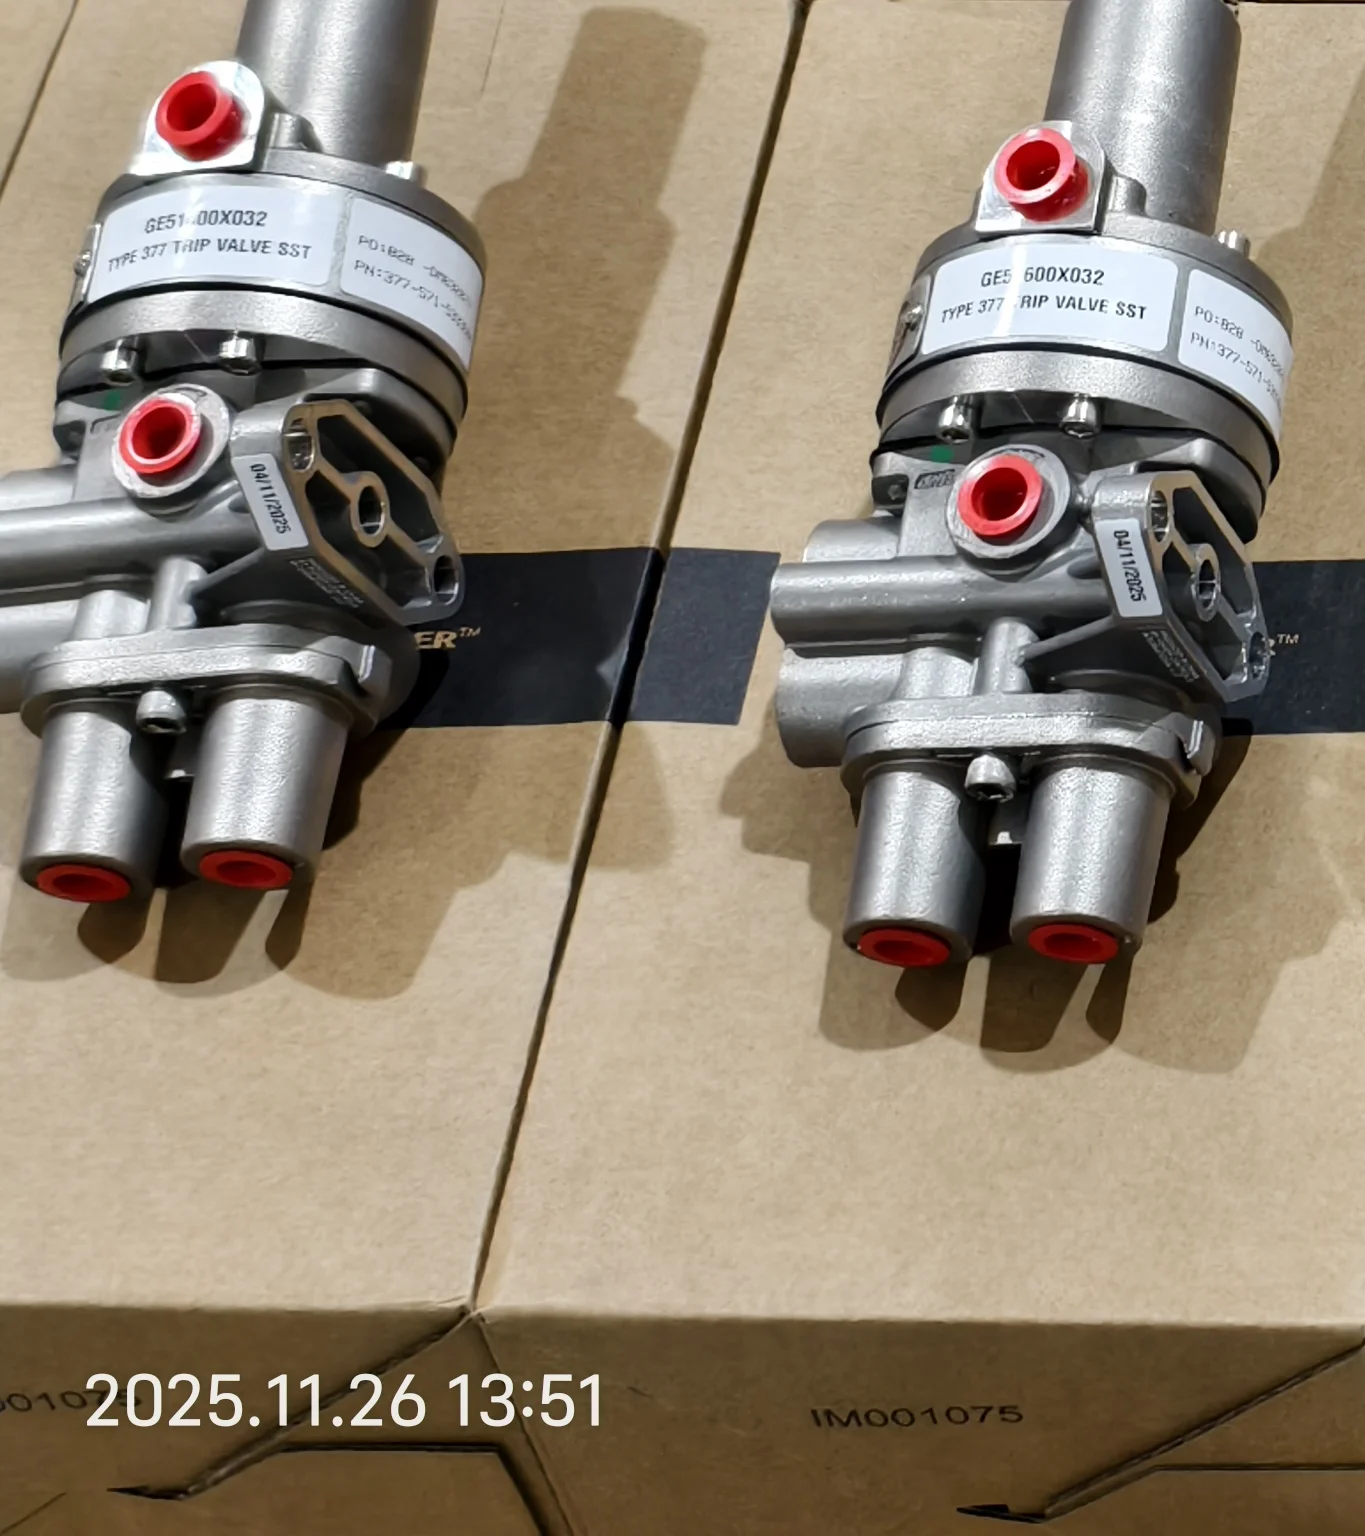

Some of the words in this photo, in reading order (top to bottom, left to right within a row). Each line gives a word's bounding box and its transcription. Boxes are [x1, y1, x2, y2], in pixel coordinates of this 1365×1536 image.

[144, 210, 268, 234] GE5100X032
[108, 249, 139, 272] TYPE
[141, 242, 168, 261] 377
[172, 238, 211, 255] TRIP
[217, 238, 273, 255] VALVE
[278, 242, 313, 260] SST
[981, 266, 1105, 287] GE5600X032
[941, 301, 974, 323] TYPE
[977, 297, 1005, 314] 377
[1055, 295, 1110, 314] VALVE
[1114, 300, 1148, 320] SST
[249, 462, 293, 536] 04/11/2025
[1113, 529, 1148, 603] 04/11/2025
[810, 1404, 1024, 1428] IM001075
